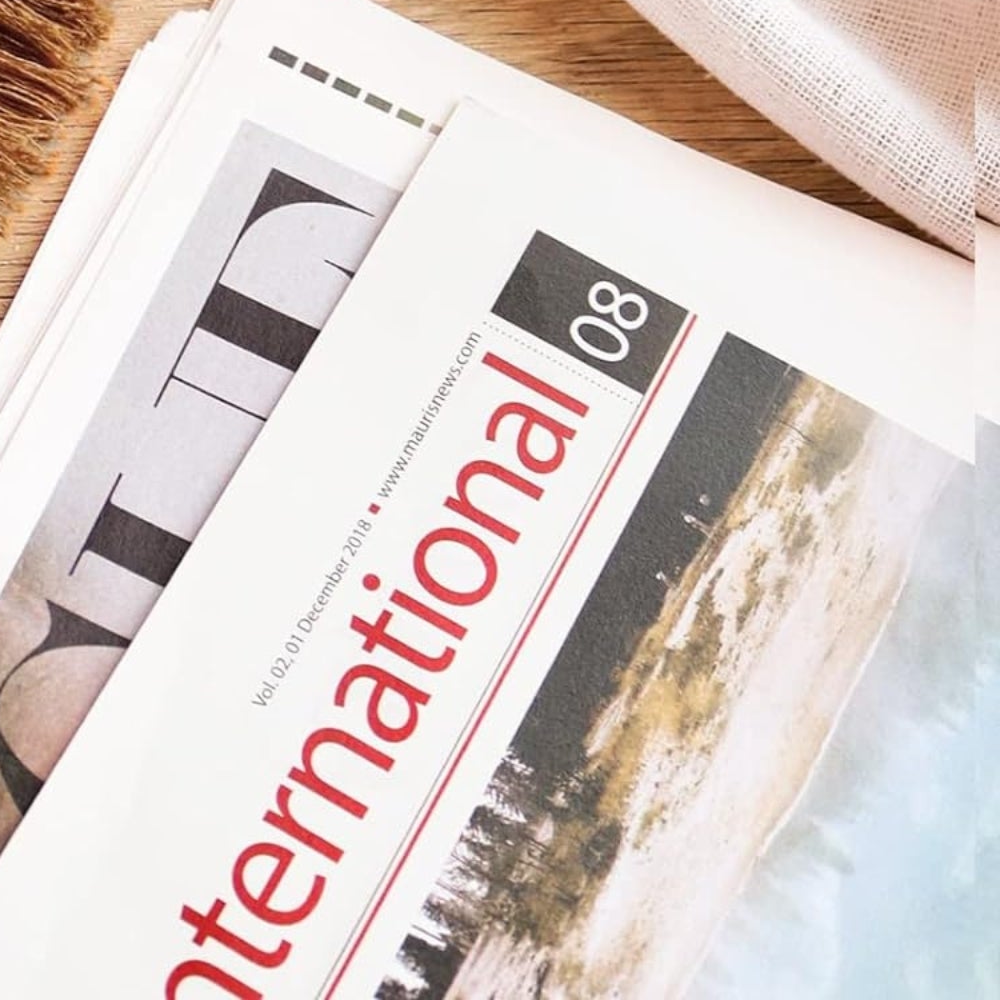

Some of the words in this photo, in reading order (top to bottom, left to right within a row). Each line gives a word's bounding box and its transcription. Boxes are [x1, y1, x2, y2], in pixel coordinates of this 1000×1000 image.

[569, 280, 649, 362] 08
[251, 680, 280, 708] Vol.
[270, 656, 295, 680] 02,
[284, 634, 305, 655] 01
[296, 556, 351, 634] December
[342, 519, 373, 558] 2018
[377, 331, 482, 498] www.maurisnews.com
